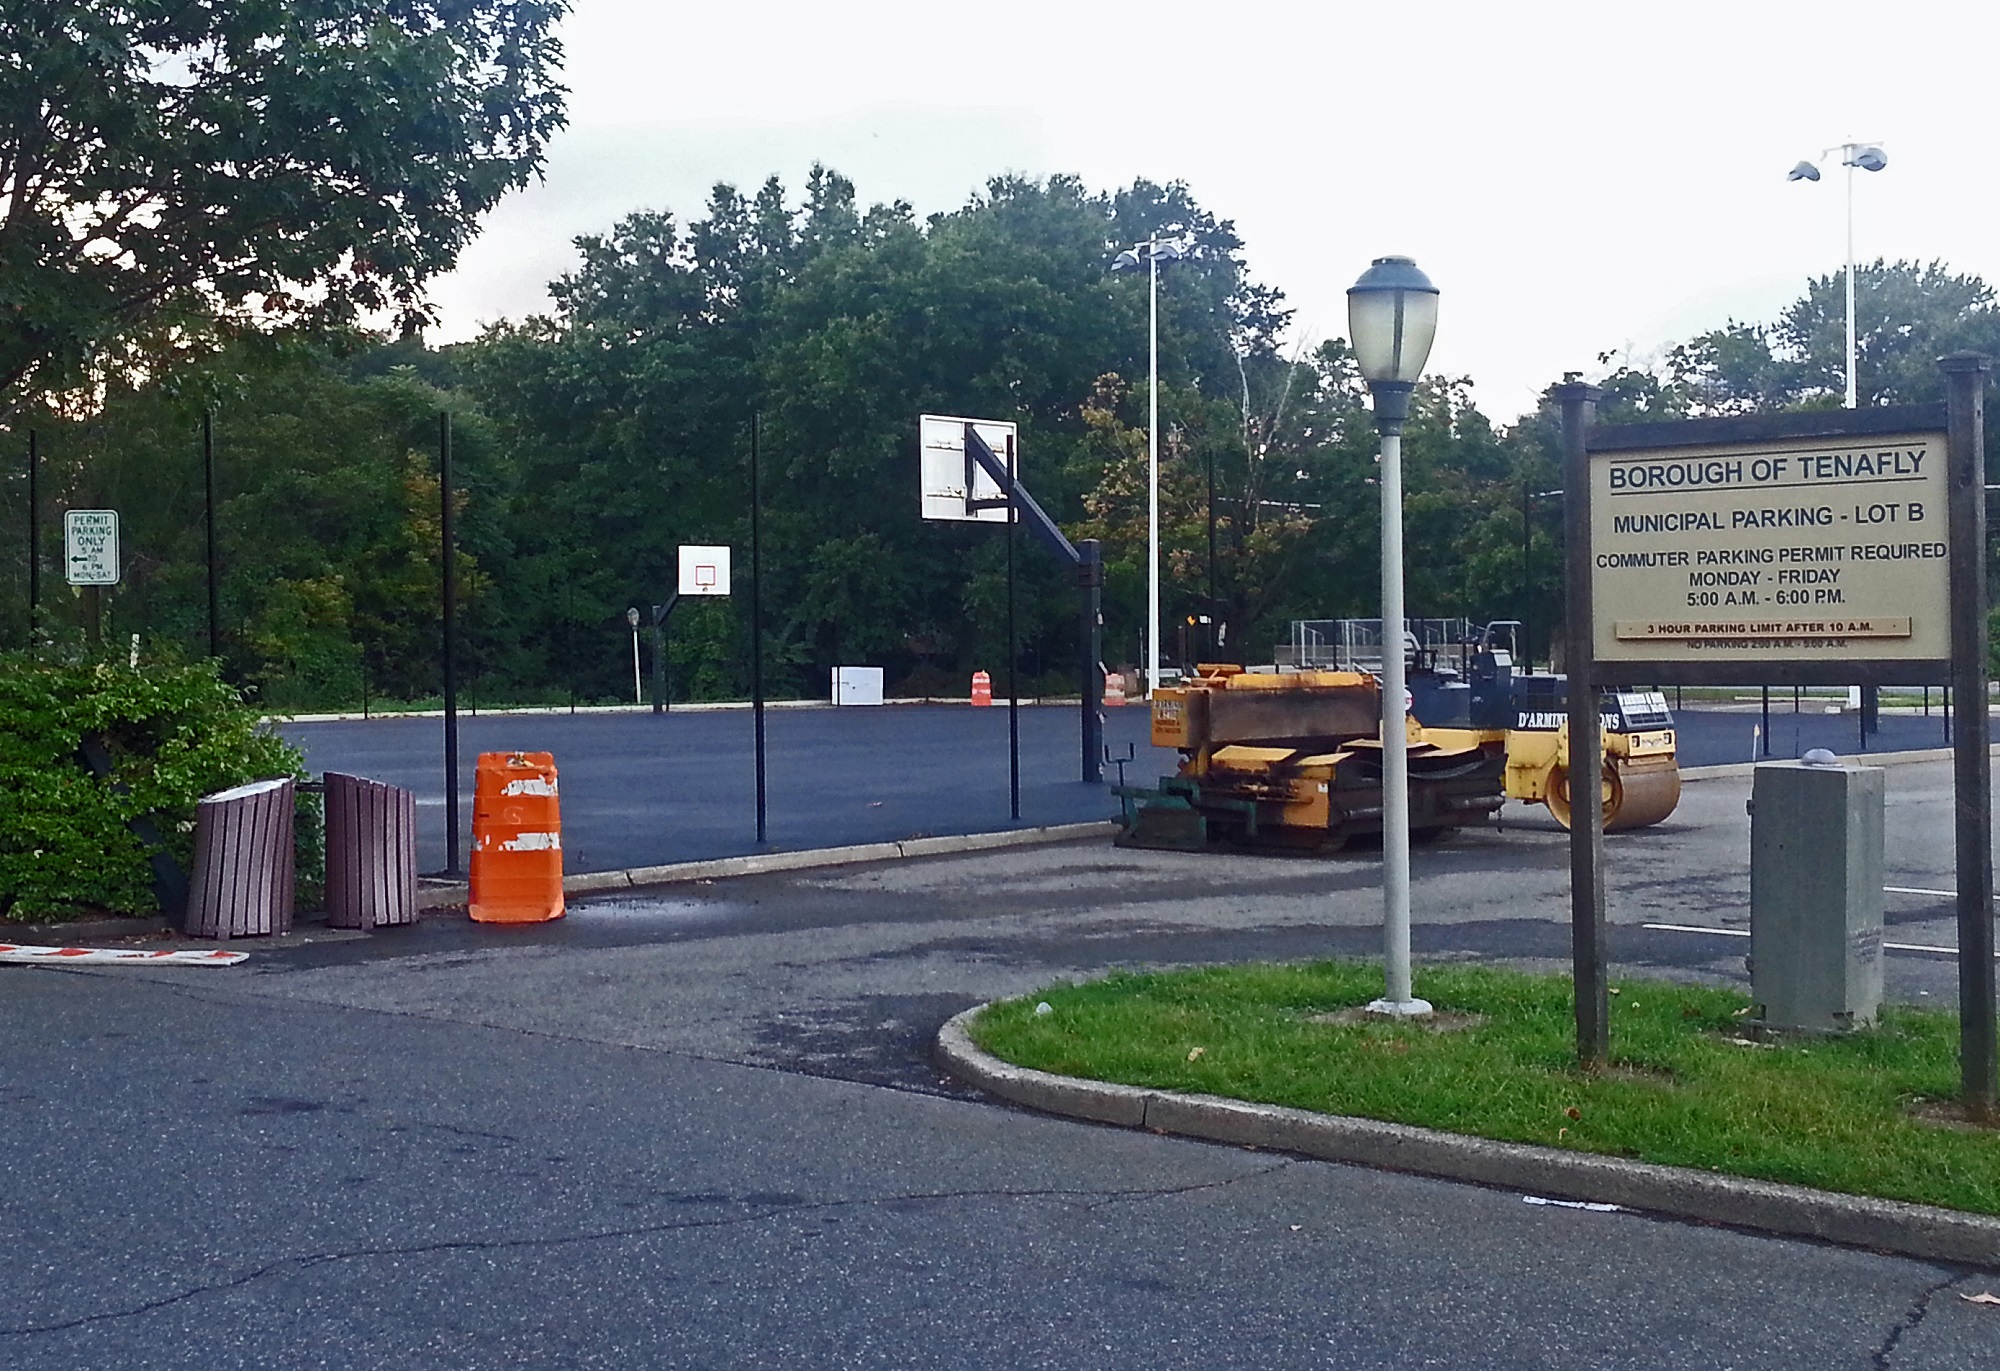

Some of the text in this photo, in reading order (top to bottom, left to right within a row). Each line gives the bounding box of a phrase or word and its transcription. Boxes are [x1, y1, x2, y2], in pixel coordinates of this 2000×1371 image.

[1610, 450, 1926, 489] BOROUGH OF TENAFLY
[74, 516, 108, 525] PERMIT
[1614, 512, 1725, 533] MUNICIPAL
[1732, 507, 1833, 529] PARKING
[1855, 504, 1900, 524] LOT
[1908, 503, 1924, 521] B
[72, 526, 112, 536] PARKING
[78, 536, 106, 546] ONLY
[1596, 542, 1947, 568] COMMUTER PARKING PERMIT REQUIRED
[73, 571, 111, 579] MON-SAT
[1689, 571, 1761, 587] MONDAY
[1778, 568, 1841, 584] FRIDAY
[1687, 591, 1719, 606] 5:00
[1725, 591, 1760, 606] A.M.
[1776, 589, 1810, 604] 6:00
[1815, 589, 1846, 604] P.M.
[1647, 622, 1874, 634] 3 HOUR PARKING LIMIT AFTER 10 A.M.
[1687, 640, 1701, 649] NO
[1703, 640, 1748, 649] PARKING
[1751, 640, 1771, 649] 2:00
[1773, 640, 1794, 649] A.M.
[1825, 639, 1847, 648] A.M.
